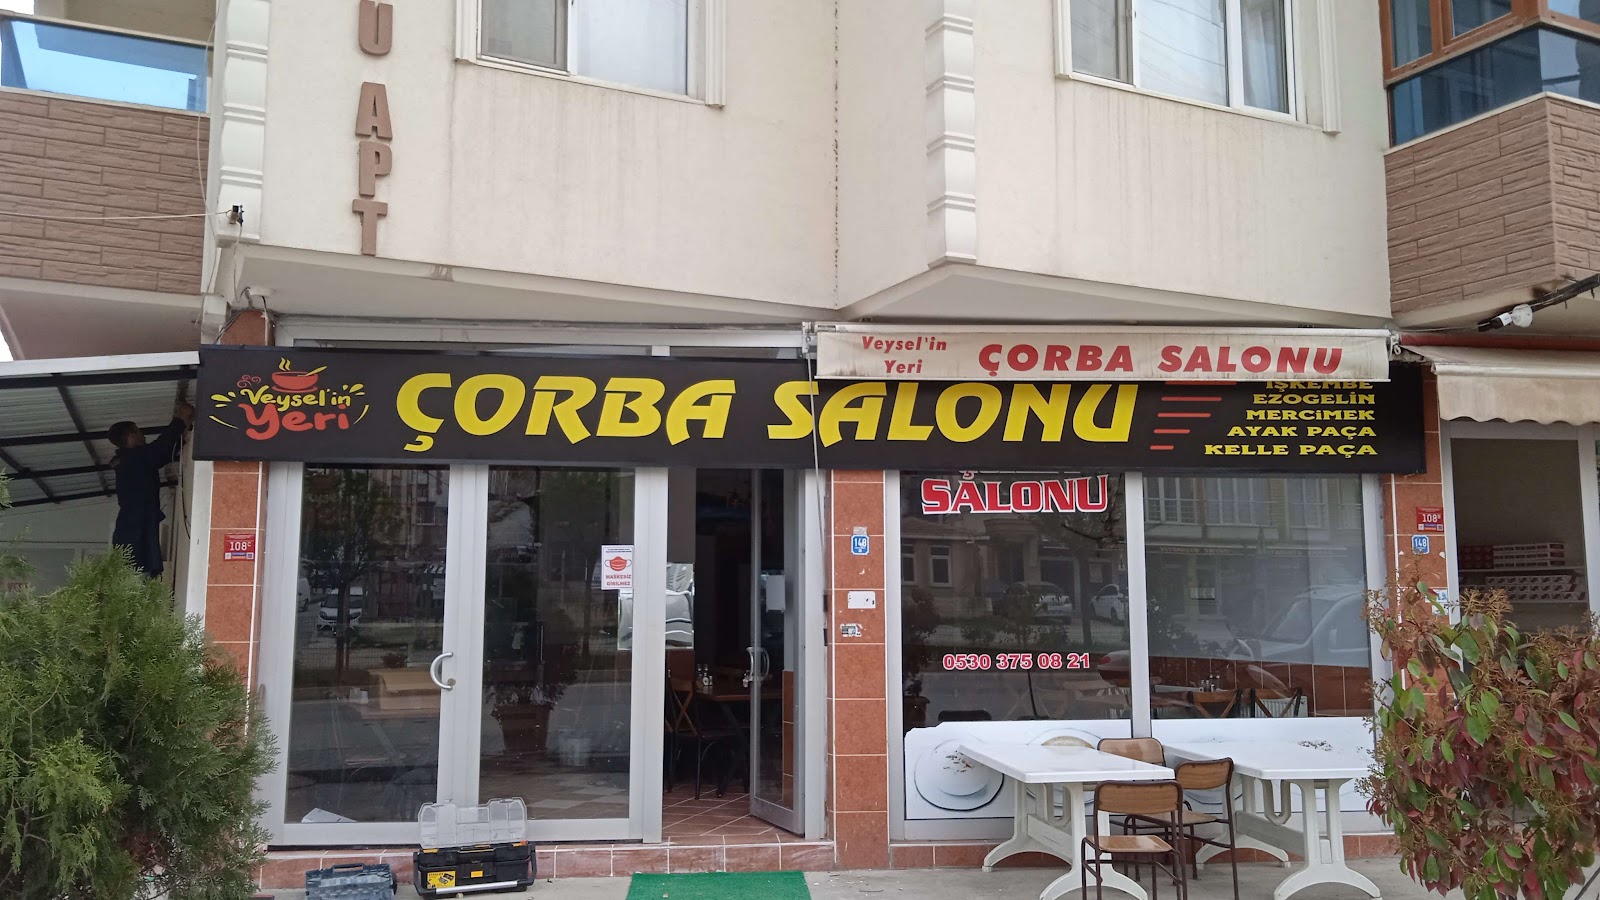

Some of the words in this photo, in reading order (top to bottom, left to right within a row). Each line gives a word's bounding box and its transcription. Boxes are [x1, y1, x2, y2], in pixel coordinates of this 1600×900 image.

[352, 81, 393, 257] APT
[861, 336, 948, 353] Veysel'in
[884, 359, 923, 374] Yeri
[978, 343, 1134, 377] ÇORBA
[1157, 345, 1343, 374] SALONU
[240, 384, 351, 412] Veysel'in
[1253, 391, 1376, 405] EZOGELİN
[396, 372, 736, 452] ÇORBA
[767, 380, 1139, 447] SALONU
[1227, 426, 1298, 437] AYAK
[1306, 426, 1377, 440] PAÇA
[1204, 444, 1289, 455] KELLE
[1299, 444, 1378, 459] PAÇA
[921, 474, 1109, 514] SALONU
[854, 538, 867, 549] 148
[943, 653, 992, 670] 0530
[996, 653, 1033, 670] 375
[1037, 653, 1063, 670] 08
[1067, 653, 1090, 669] 21
